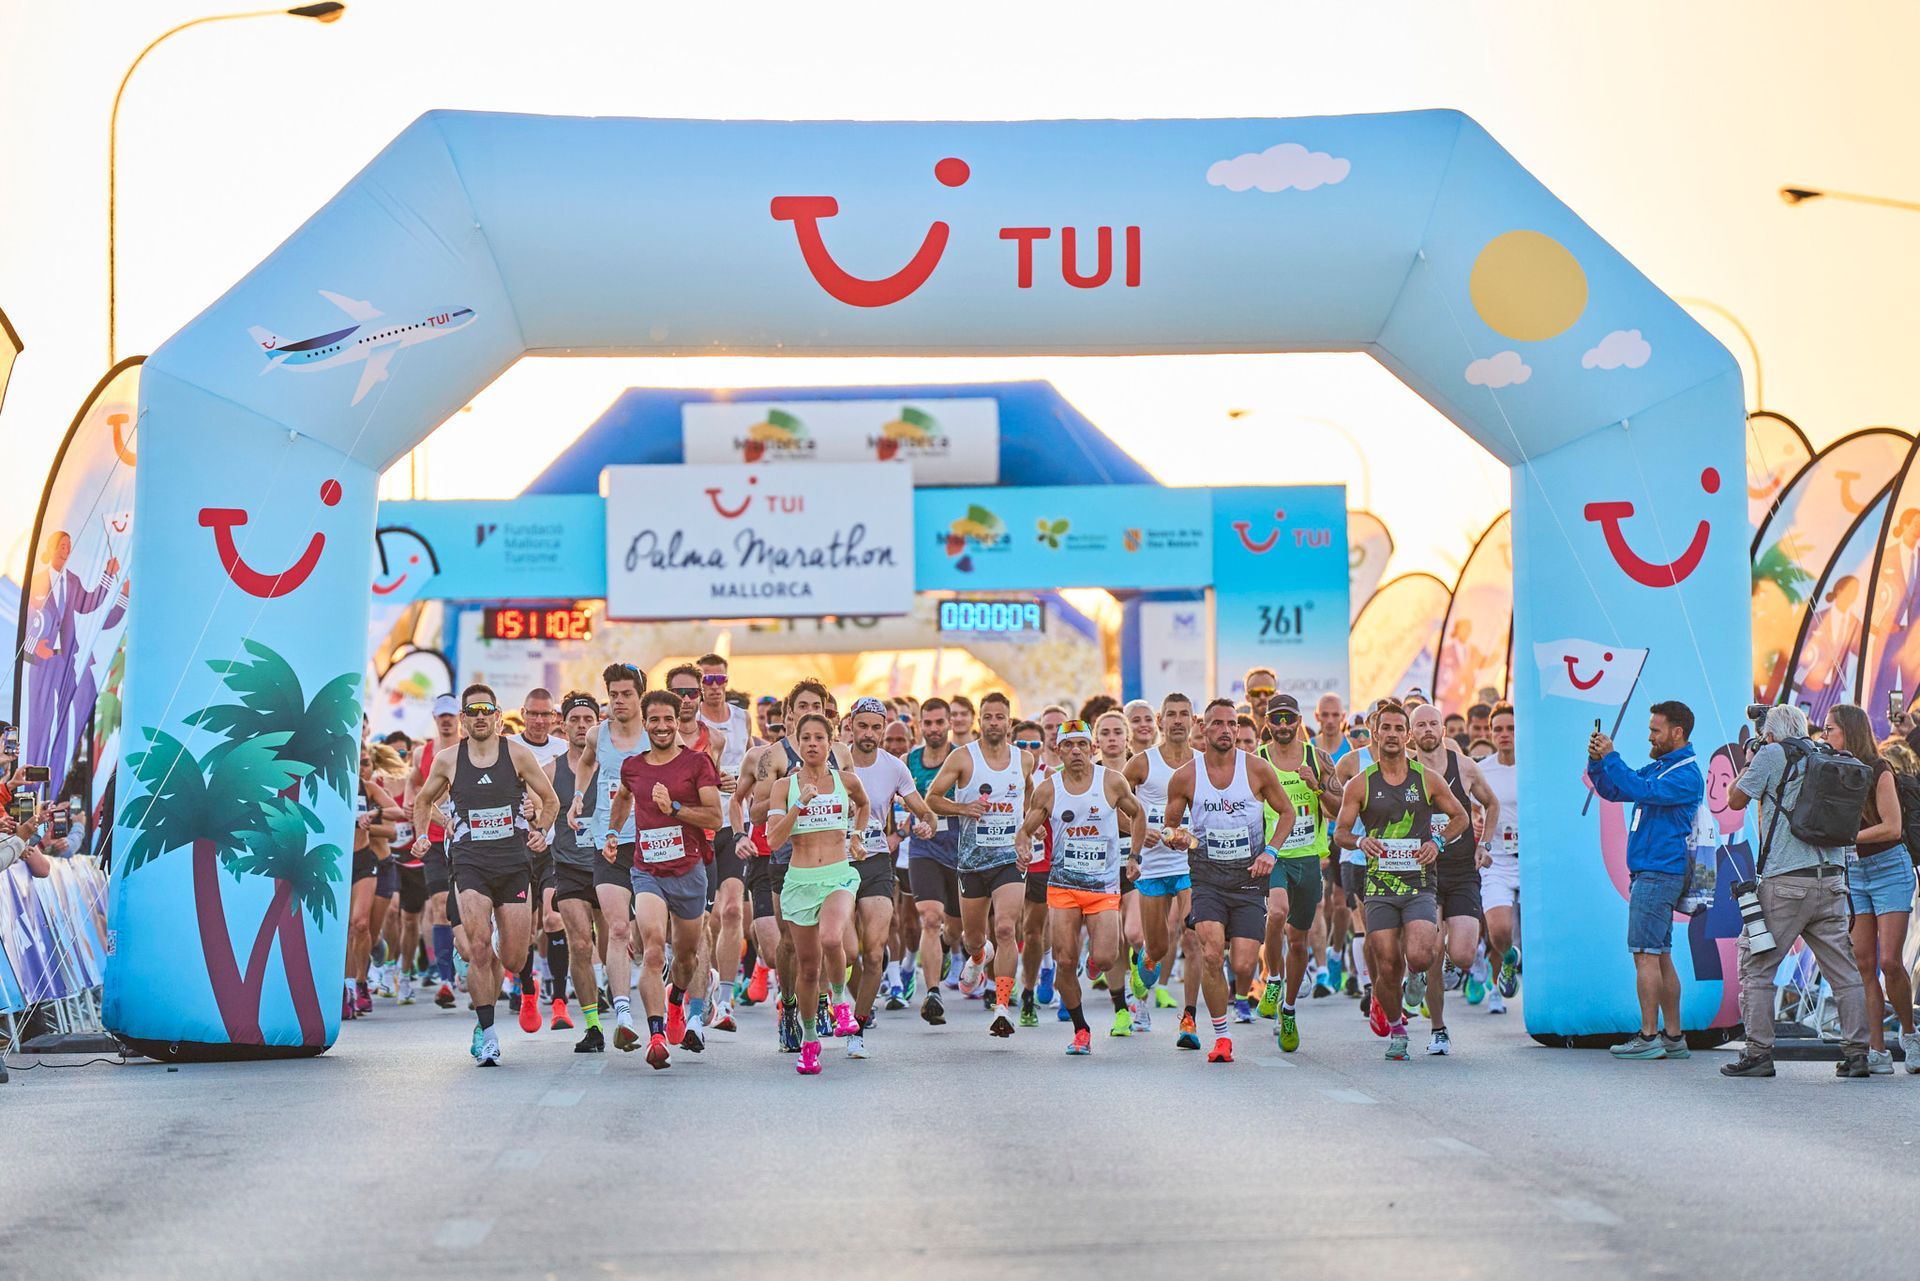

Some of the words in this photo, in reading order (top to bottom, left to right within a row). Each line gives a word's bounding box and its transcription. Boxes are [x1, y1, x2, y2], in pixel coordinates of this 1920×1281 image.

[999, 226, 1141, 289] TUI
[427, 312, 450, 327] TUI
[766, 496, 804, 512] TUI
[1293, 529, 1330, 546] TUI
[625, 529, 727, 572] Palma
[734, 522, 898, 574] Marathon
[711, 582, 813, 598] MALLORCA
[941, 602, 1040, 631] 000009
[806, 805, 834, 816] 3901
[478, 817, 505, 828] 4264
[987, 826, 1006, 835] 697
[1066, 825, 1100, 838] VIVA
[647, 837, 675, 850] 3902
[1217, 839, 1237, 849] 791
[1072, 851, 1099, 860] 1510
[1386, 850, 1413, 859] 6456
